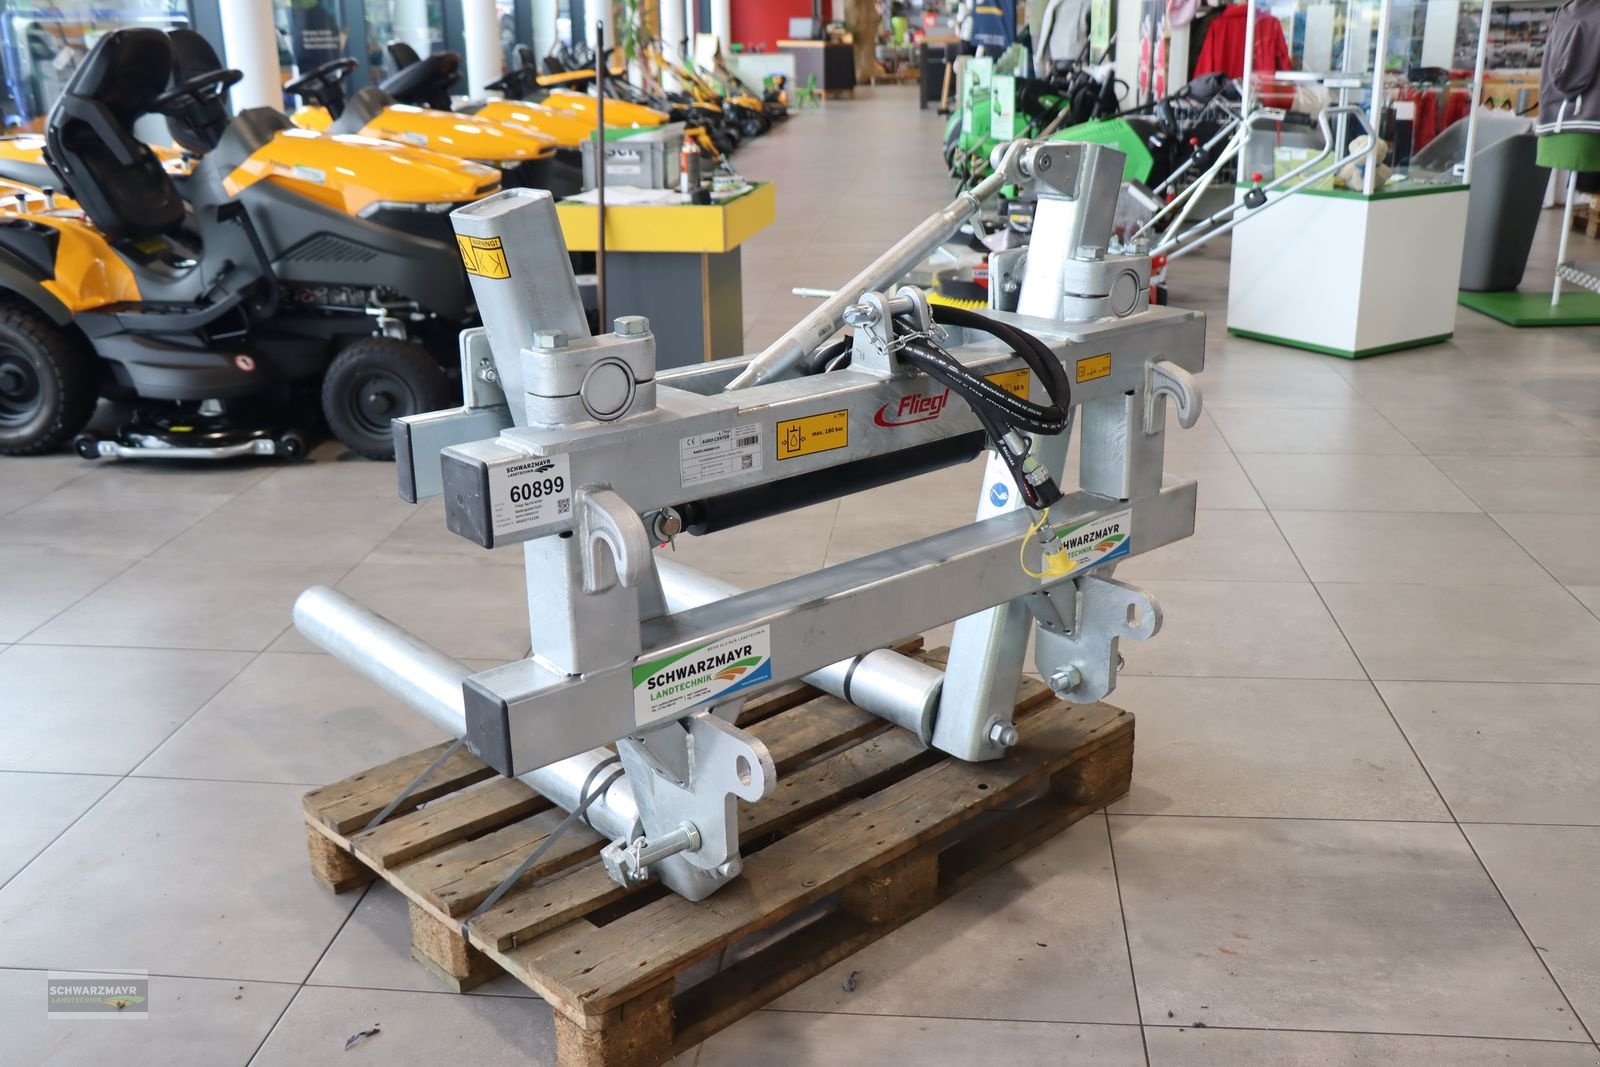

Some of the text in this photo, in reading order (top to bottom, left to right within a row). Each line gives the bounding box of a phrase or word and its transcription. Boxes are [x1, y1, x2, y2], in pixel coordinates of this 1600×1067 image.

[897, 387, 950, 417] Fliegl
[506, 458, 551, 474] SCHWARZMAYR
[510, 476, 564, 503] 60899
[1062, 523, 1120, 551] HWARZMAYR
[1067, 545, 1093, 559] TECHNIK
[647, 644, 752, 691] SCHWARZMAYR
[650, 672, 713, 702] LANDTECHNIK
